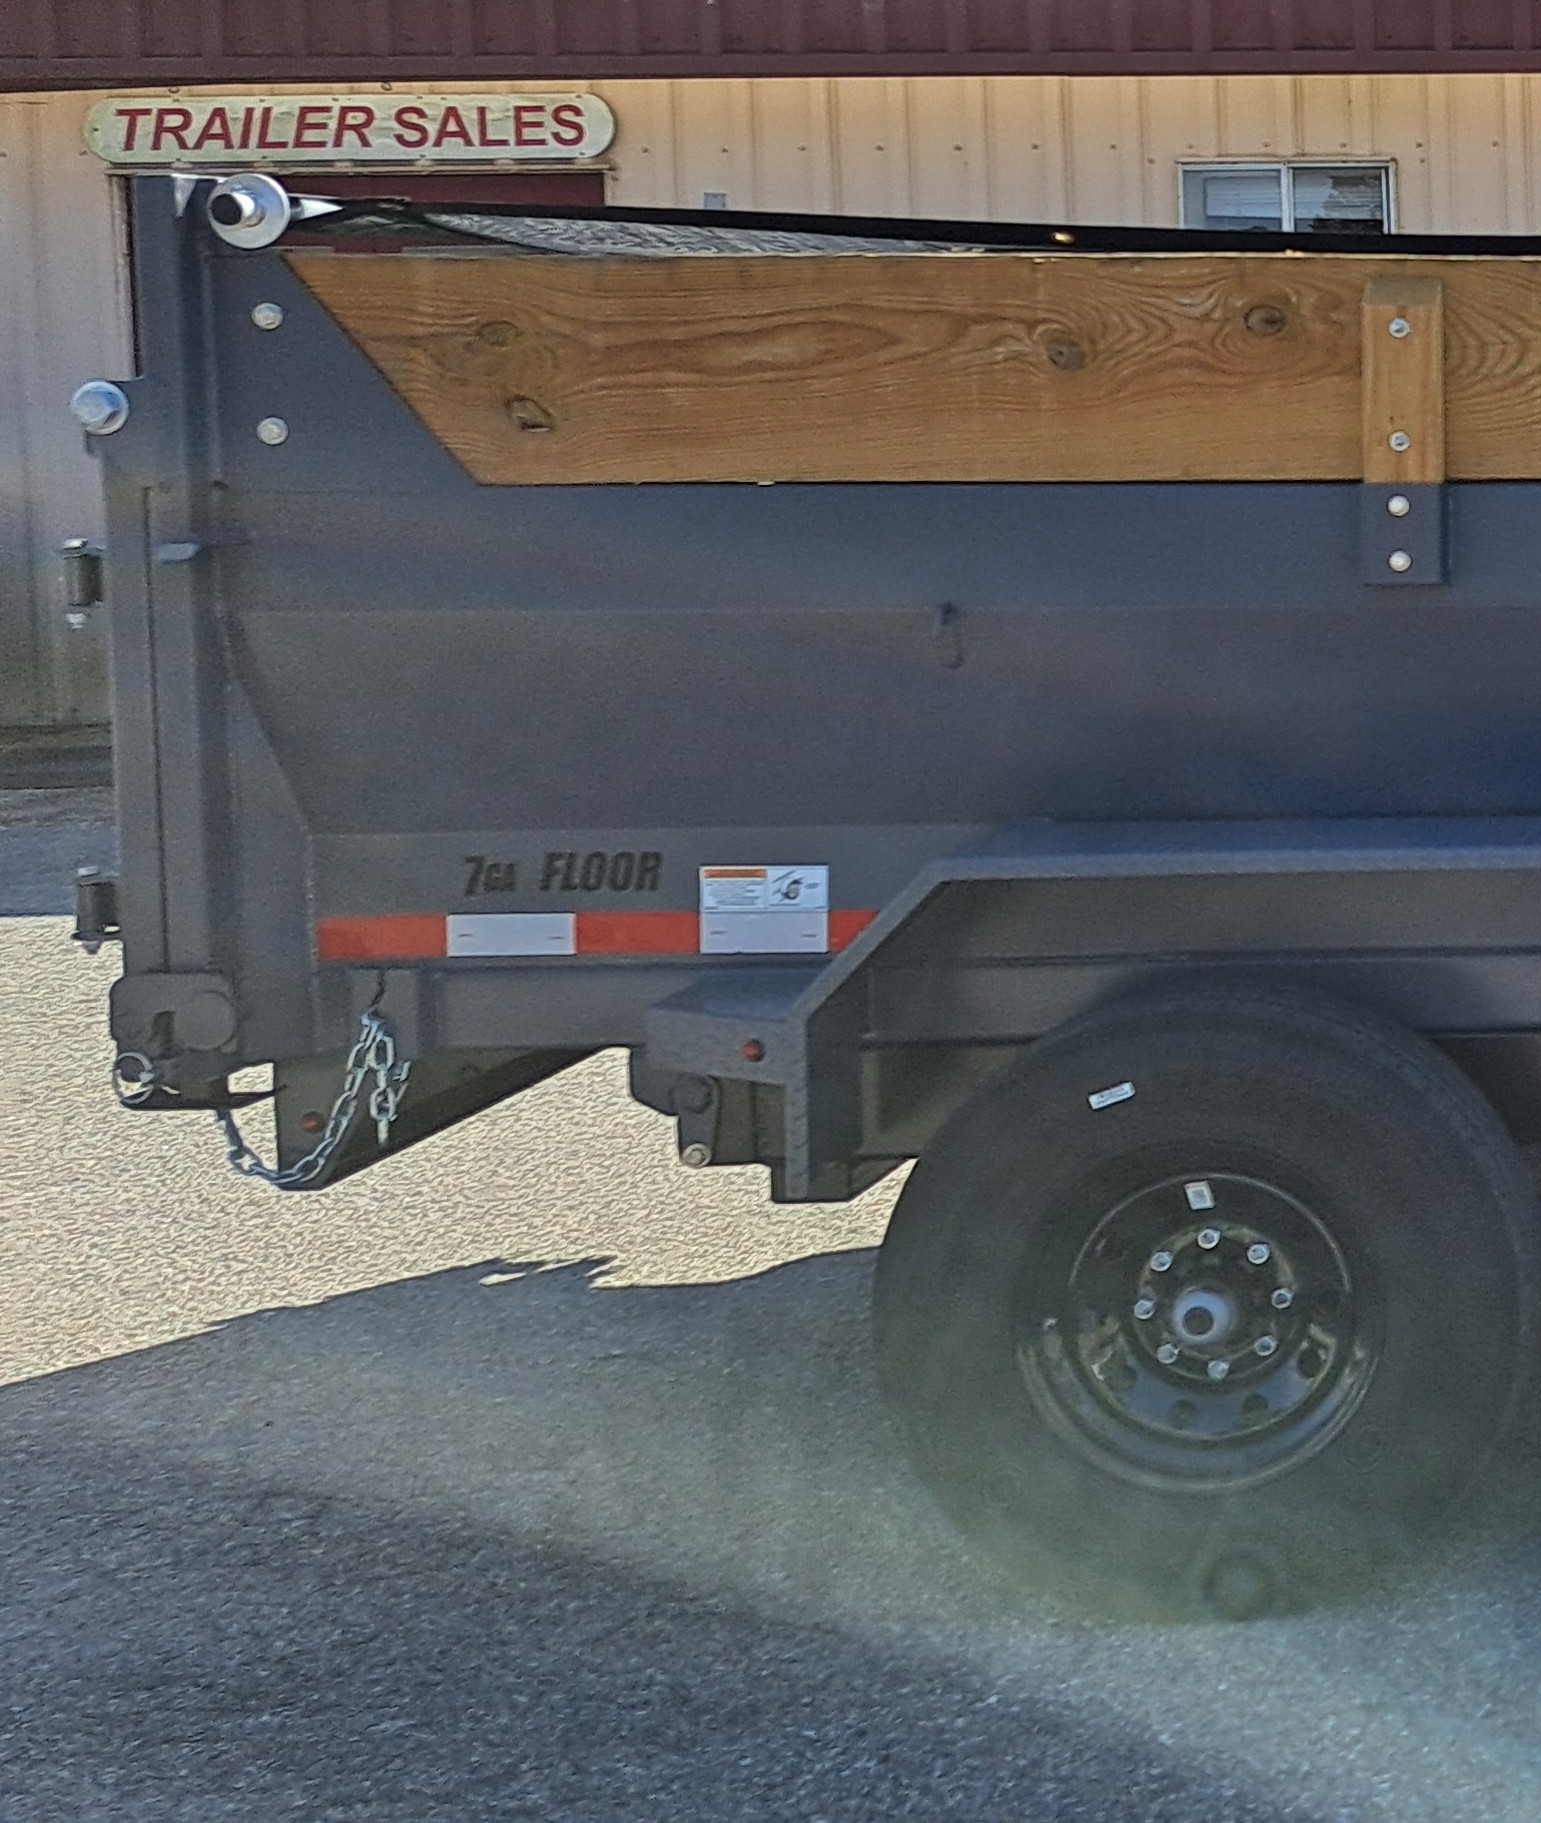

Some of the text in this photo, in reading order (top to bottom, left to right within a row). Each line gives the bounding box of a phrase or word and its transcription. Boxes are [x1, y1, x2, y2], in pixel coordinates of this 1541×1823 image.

[115, 104, 585, 151] TRAILER SALES
[539, 851, 663, 893] FLOOR
